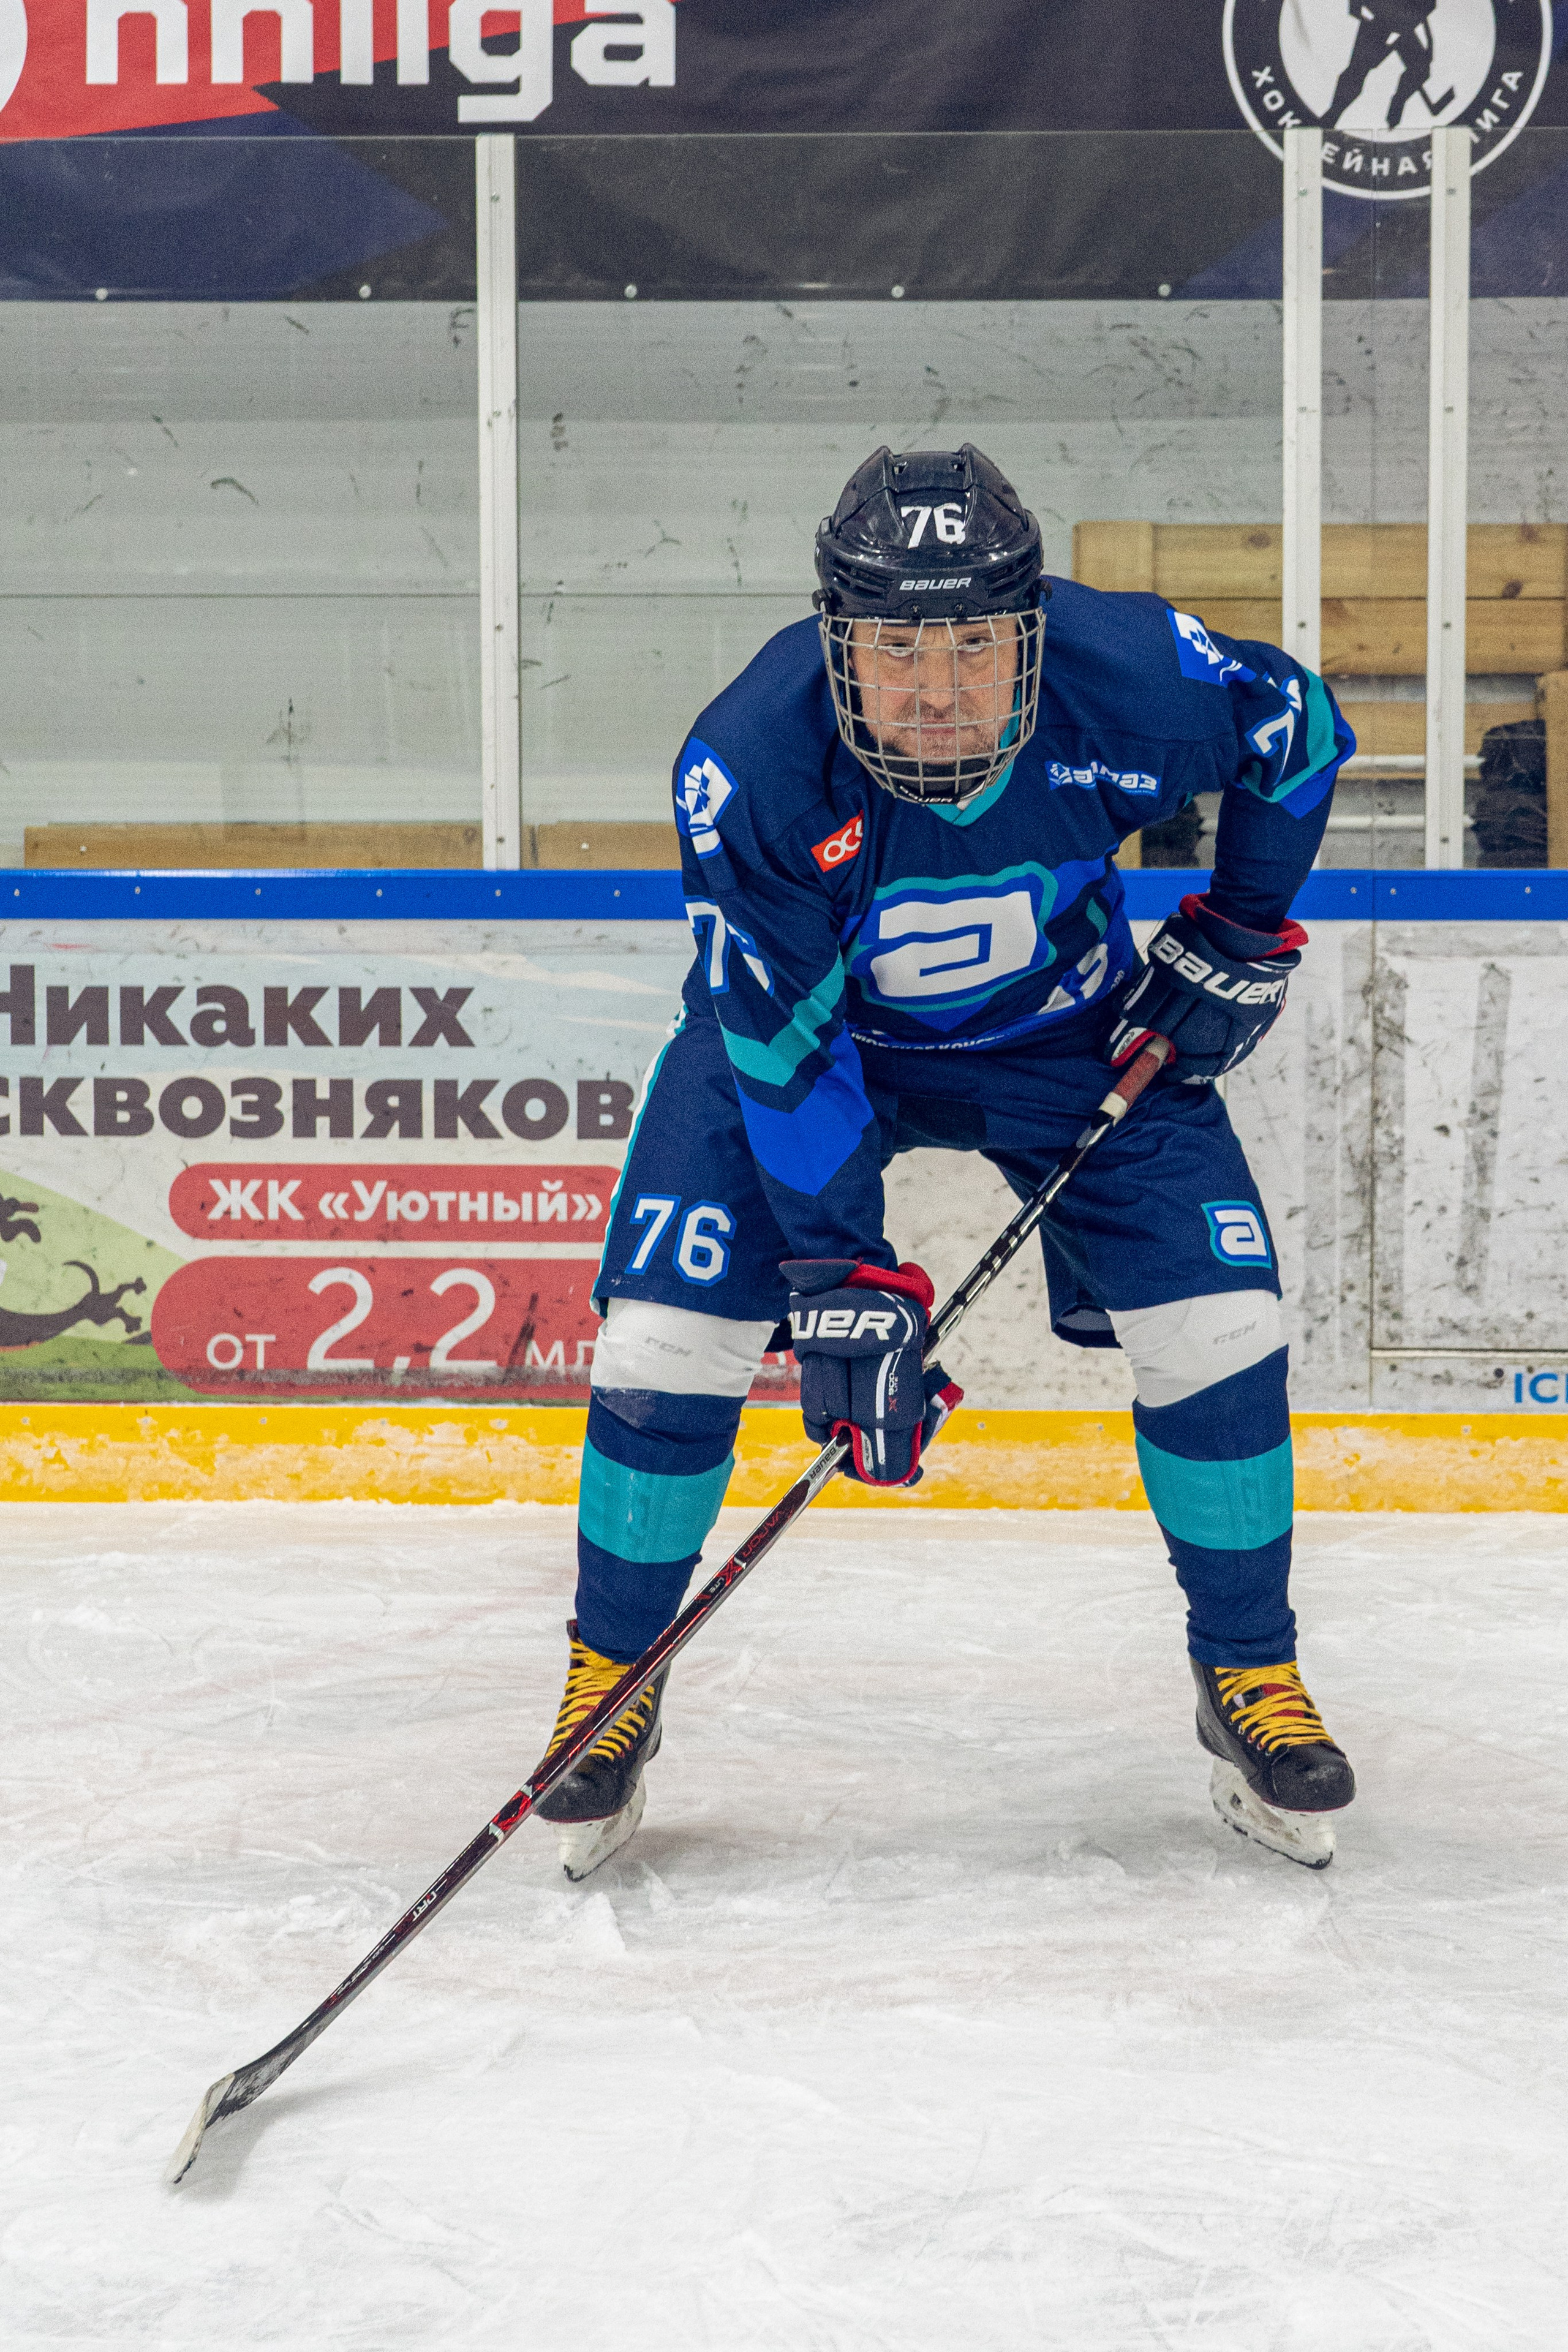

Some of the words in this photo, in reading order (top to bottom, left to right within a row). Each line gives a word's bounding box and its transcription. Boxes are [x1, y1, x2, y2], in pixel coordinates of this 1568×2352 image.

[900, 502, 966, 549] 76
[899, 576, 972, 590] BAUER
[1147, 933, 1287, 1005] BAUER
[0, 1076, 635, 1140] квозняков
[207, 1179, 304, 1221] ЖК
[318, 1180, 603, 1222] «Уютный»
[628, 1197, 733, 1283] 76
[206, 1333, 276, 1371] от
[307, 1267, 497, 1387] 2,2
[1514, 1373, 1568, 1404] IC
[809, 1447, 837, 1479] BAUER
